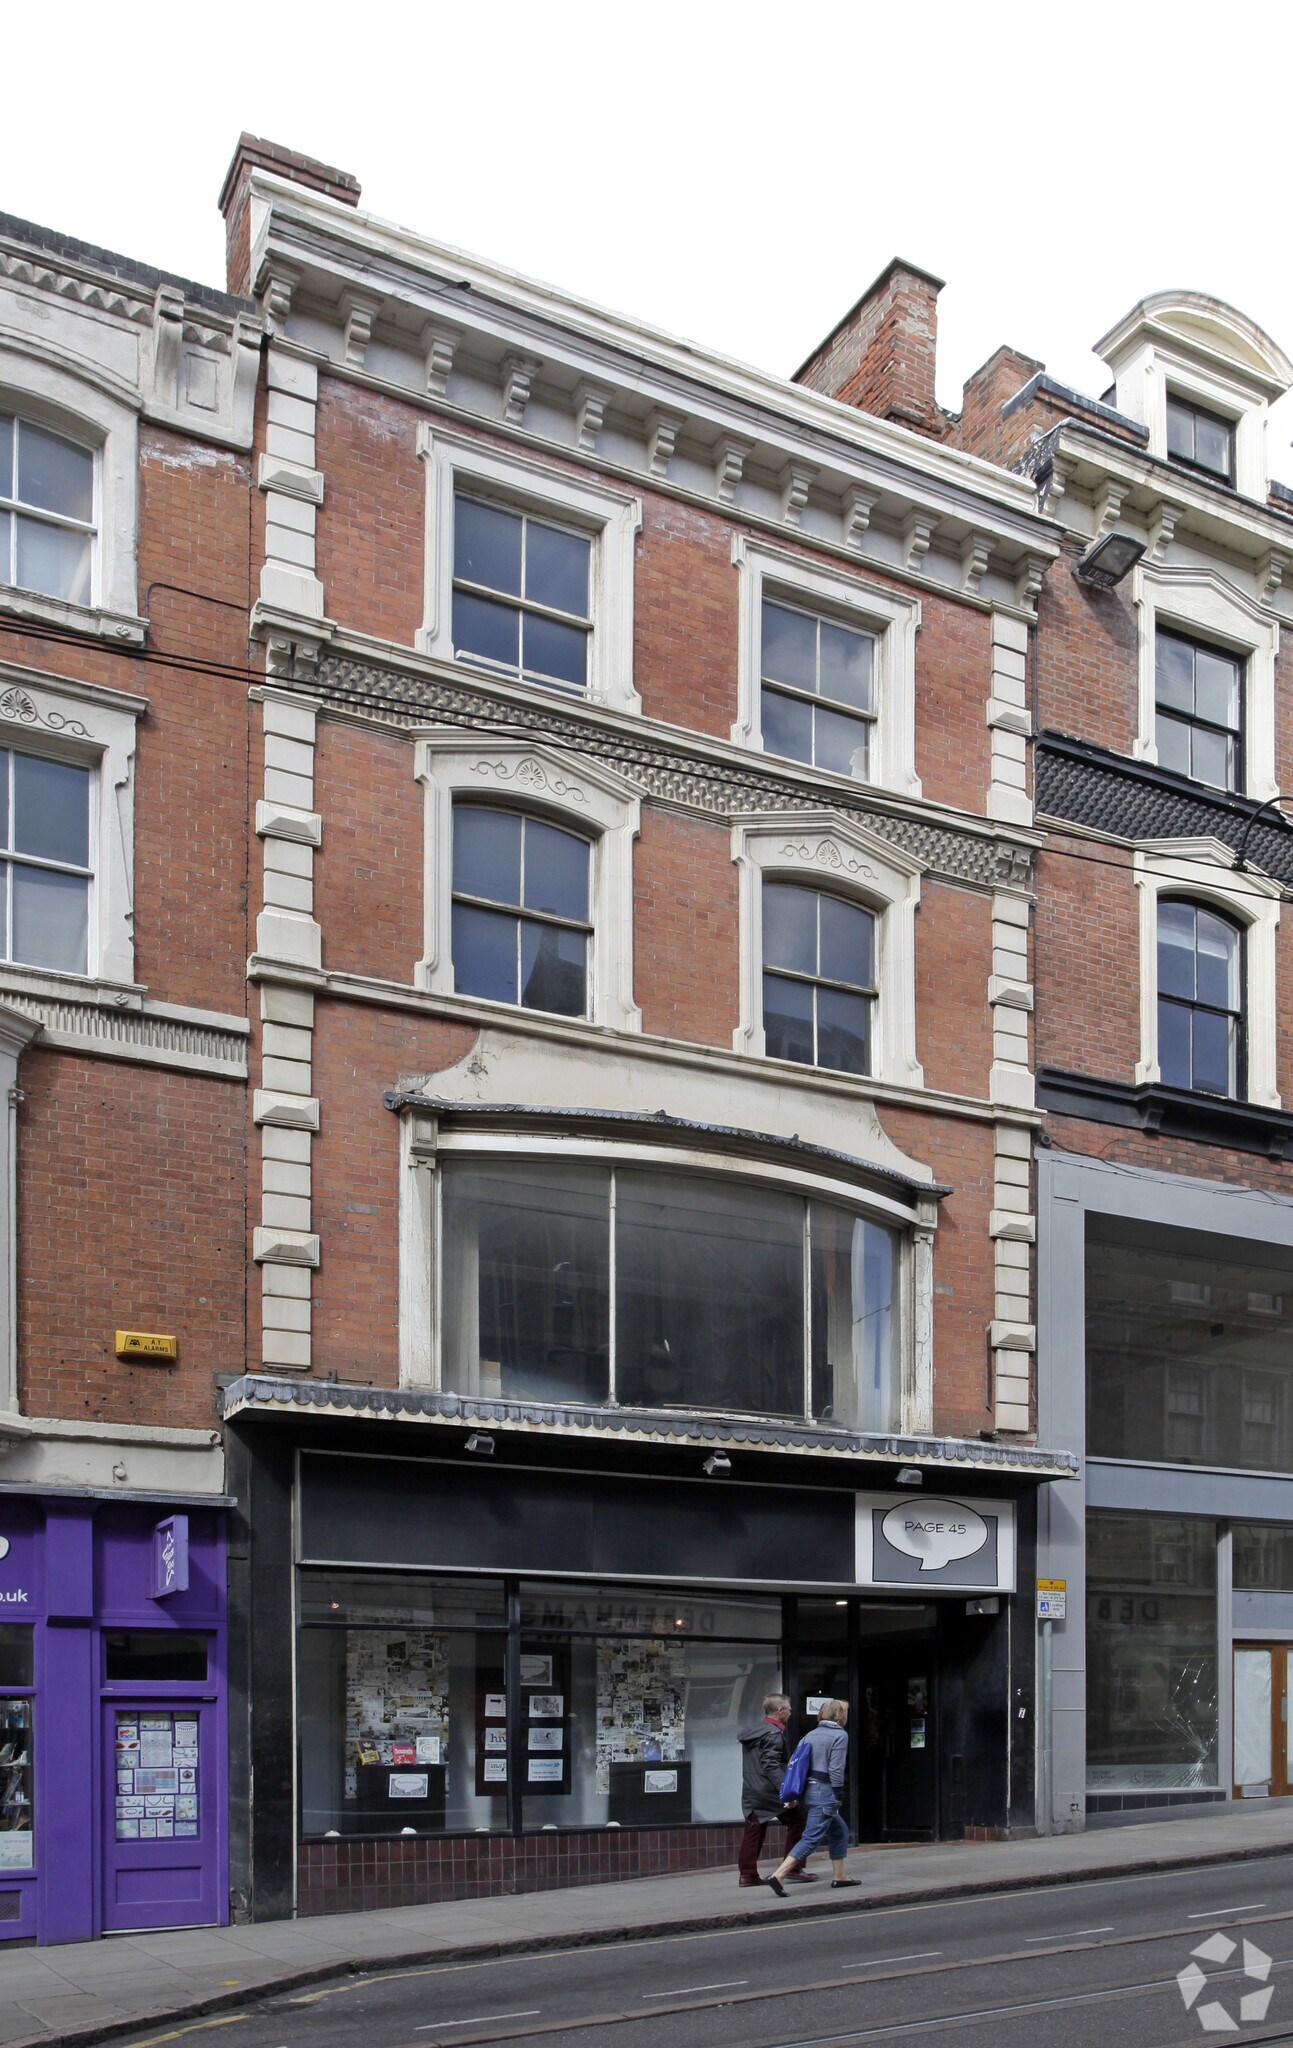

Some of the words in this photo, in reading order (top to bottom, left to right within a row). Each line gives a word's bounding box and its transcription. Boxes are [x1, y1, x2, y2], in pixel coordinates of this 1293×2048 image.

[143, 1345, 169, 1353] ALARMS
[904, 1521, 945, 1533] PAGE
[948, 1524, 967, 1535] 45
